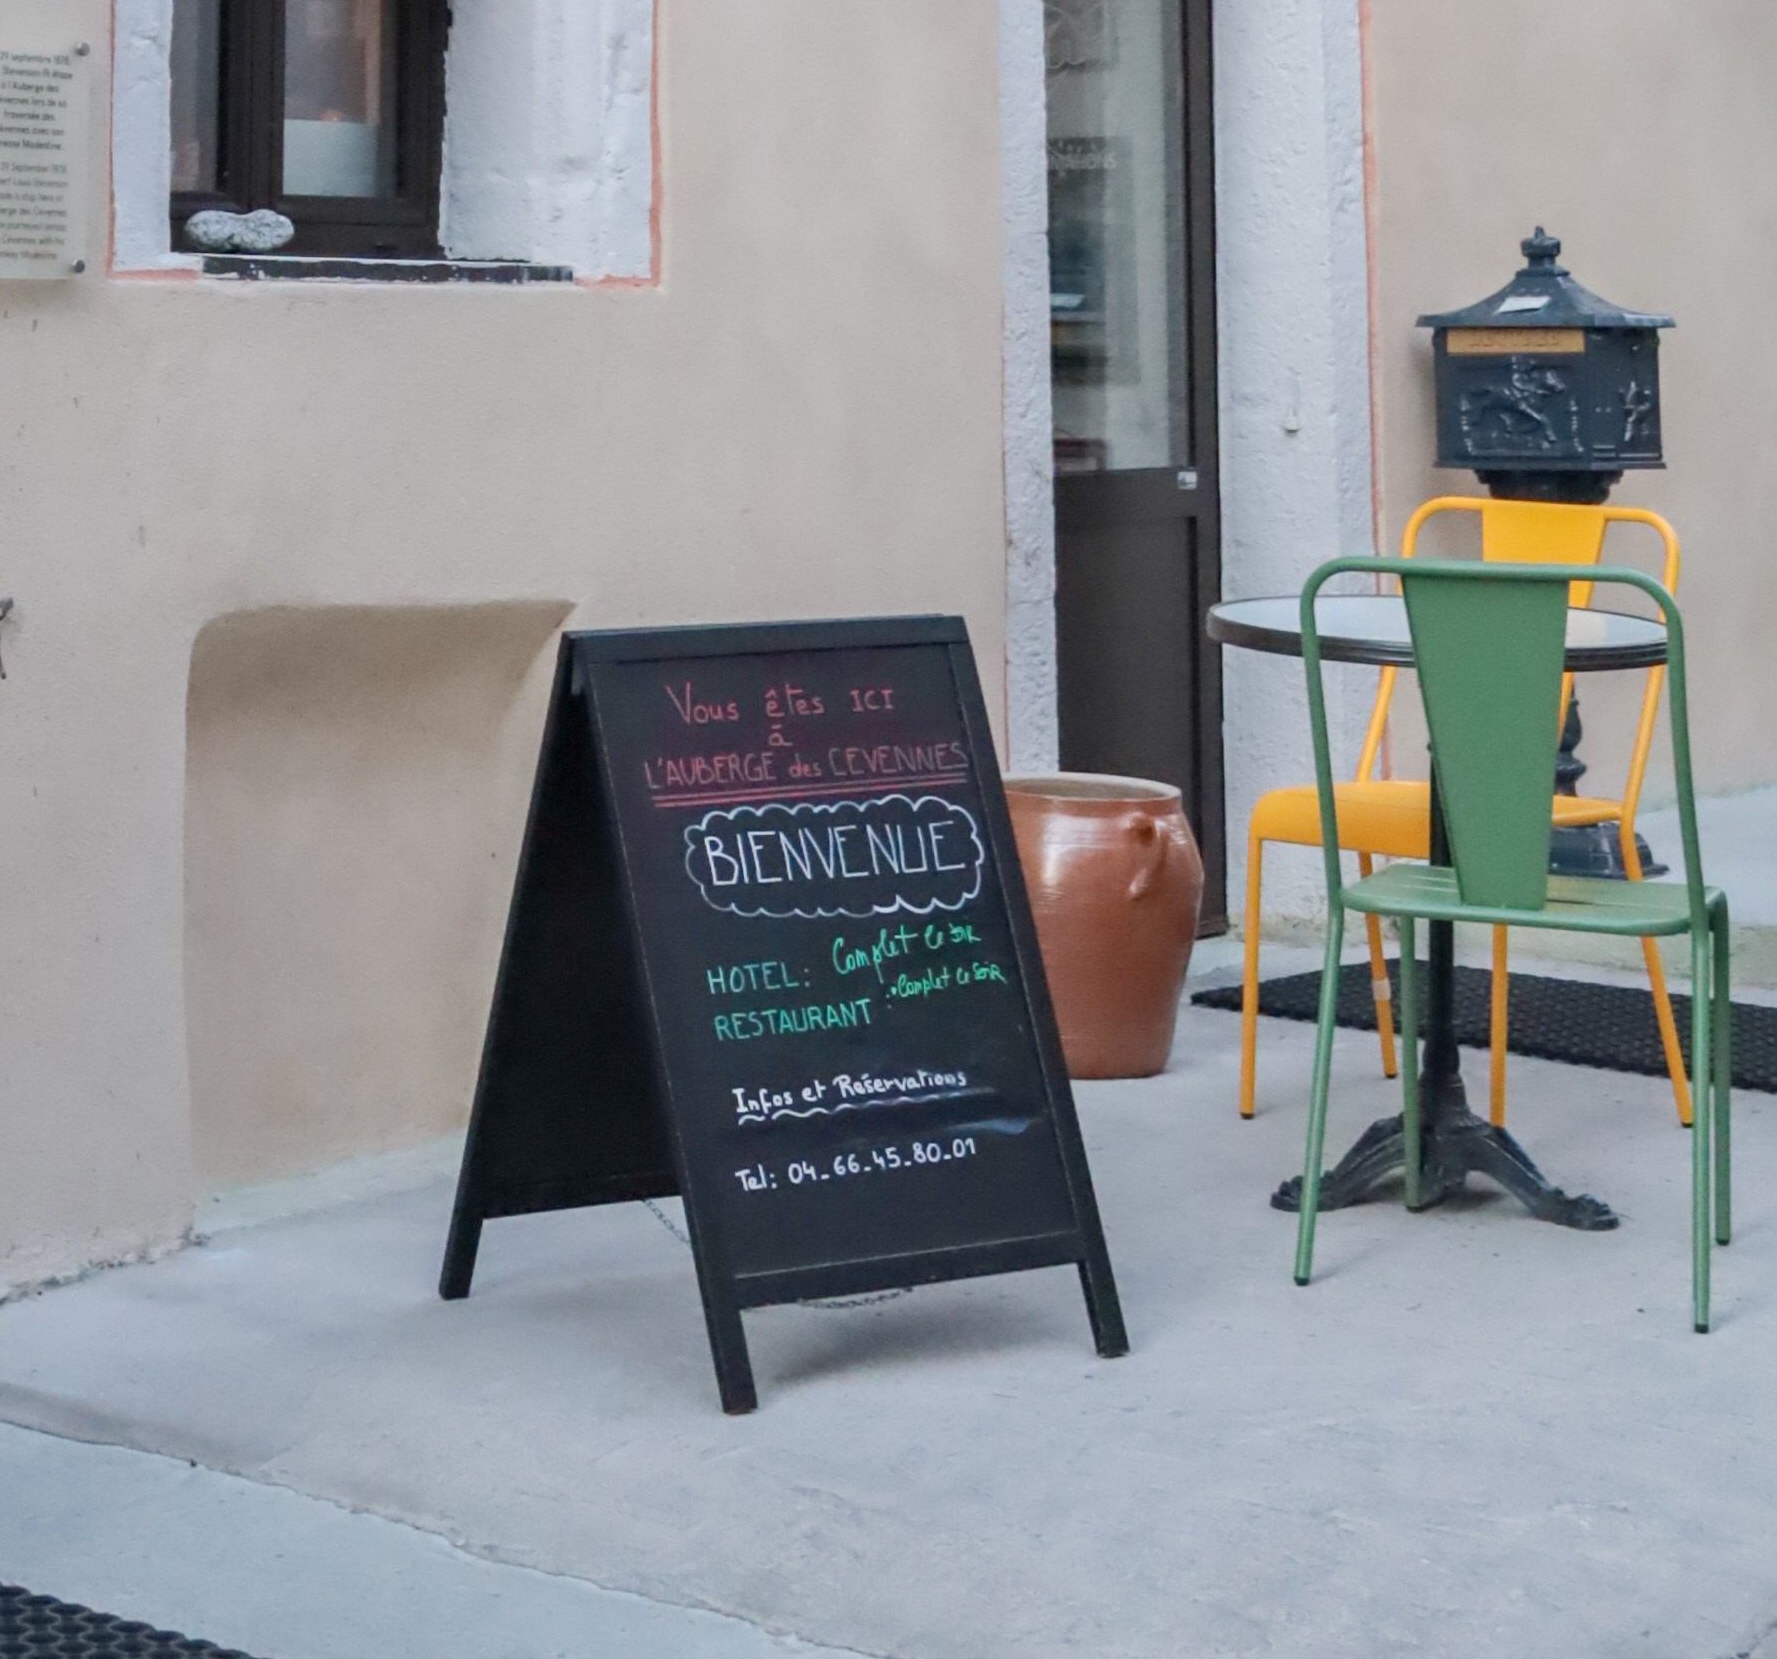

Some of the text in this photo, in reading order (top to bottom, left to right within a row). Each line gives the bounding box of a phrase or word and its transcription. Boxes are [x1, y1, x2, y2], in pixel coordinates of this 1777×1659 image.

[665, 682, 894, 724] Vous êtes ICI
[644, 742, 969, 790] L'AUBERGE des CEVENNES
[704, 820, 966, 886] BIENVENUE
[832, 924, 918, 984] Complet
[713, 998, 871, 1041] RESTAURANT
[897, 966, 950, 999] Complet
[732, 1069, 967, 1114] Infos et Réservations
